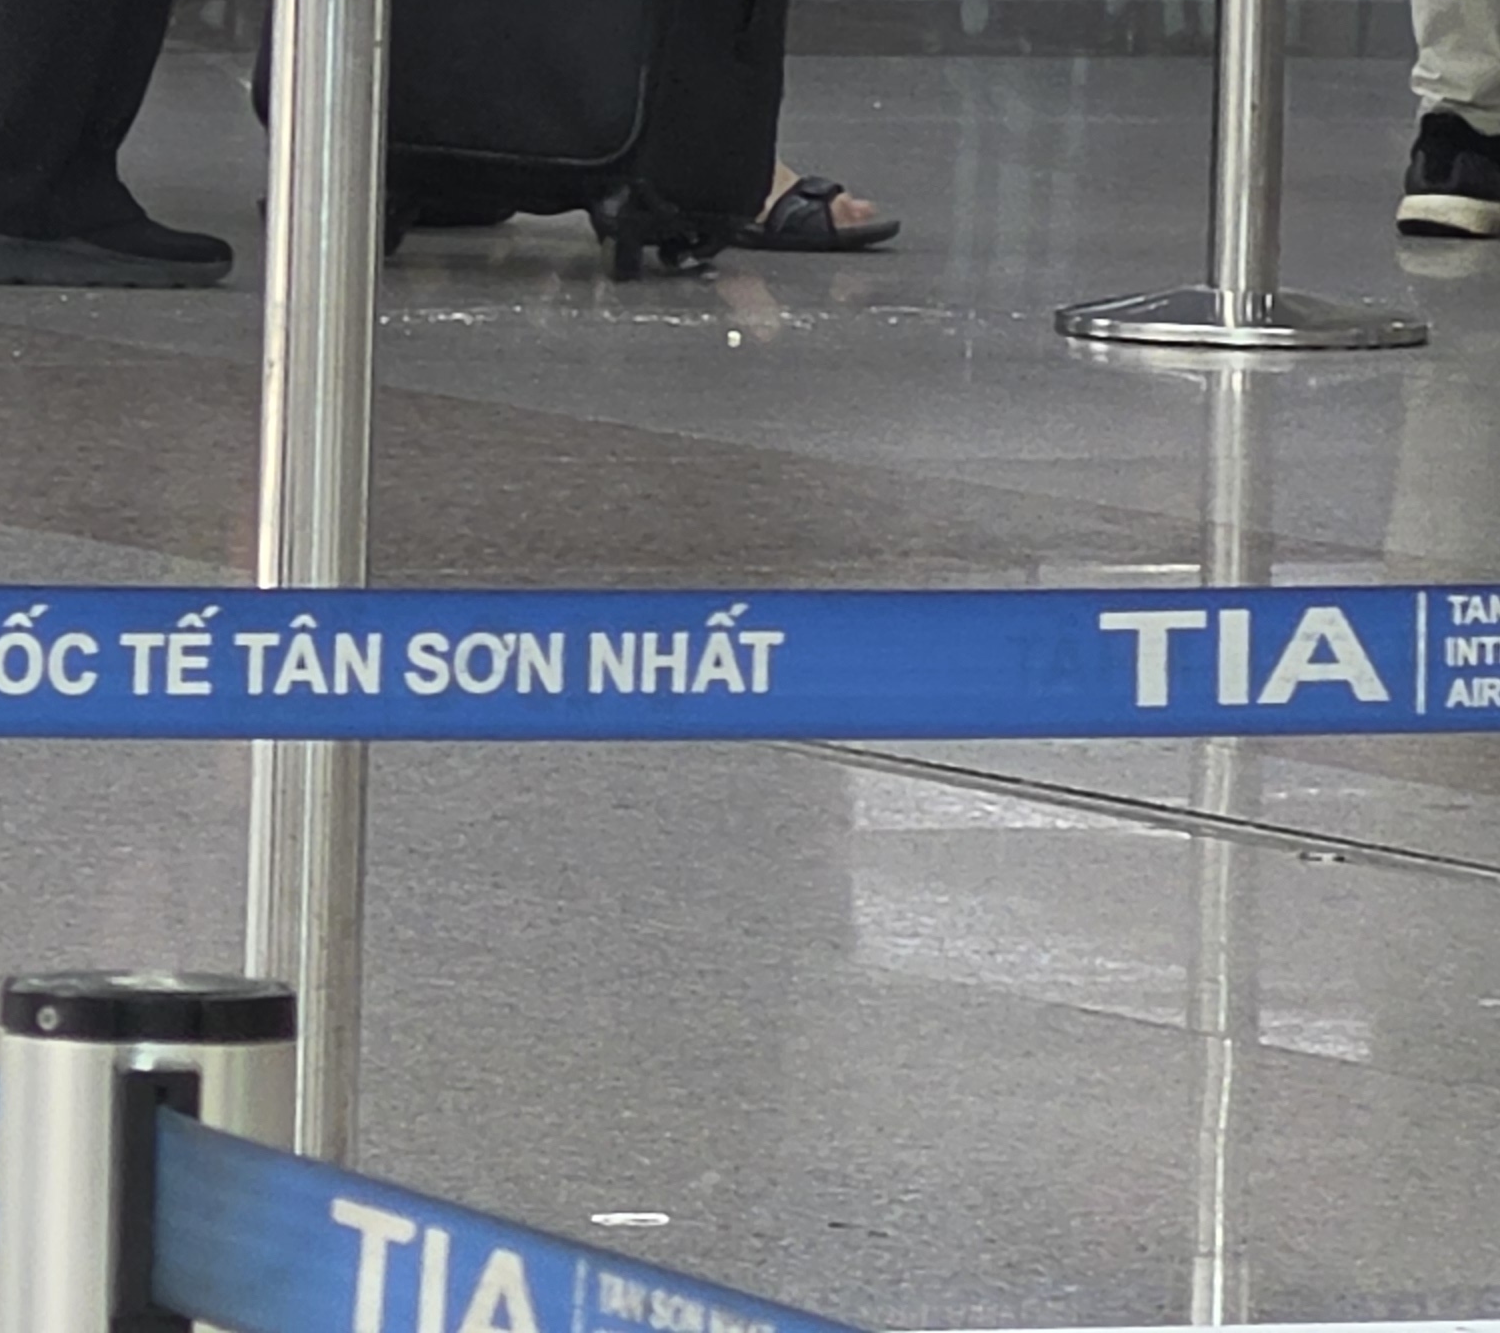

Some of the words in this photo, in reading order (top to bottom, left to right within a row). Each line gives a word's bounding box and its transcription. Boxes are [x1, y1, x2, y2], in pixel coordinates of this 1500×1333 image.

[119, 605, 222, 696] TẾ
[234, 614, 382, 696] TÂN
[403, 630, 565, 696] SƠN
[587, 603, 785, 695] NHẤT
[1099, 606, 1391, 707] TIA
[331, 1197, 541, 1333] TIA
